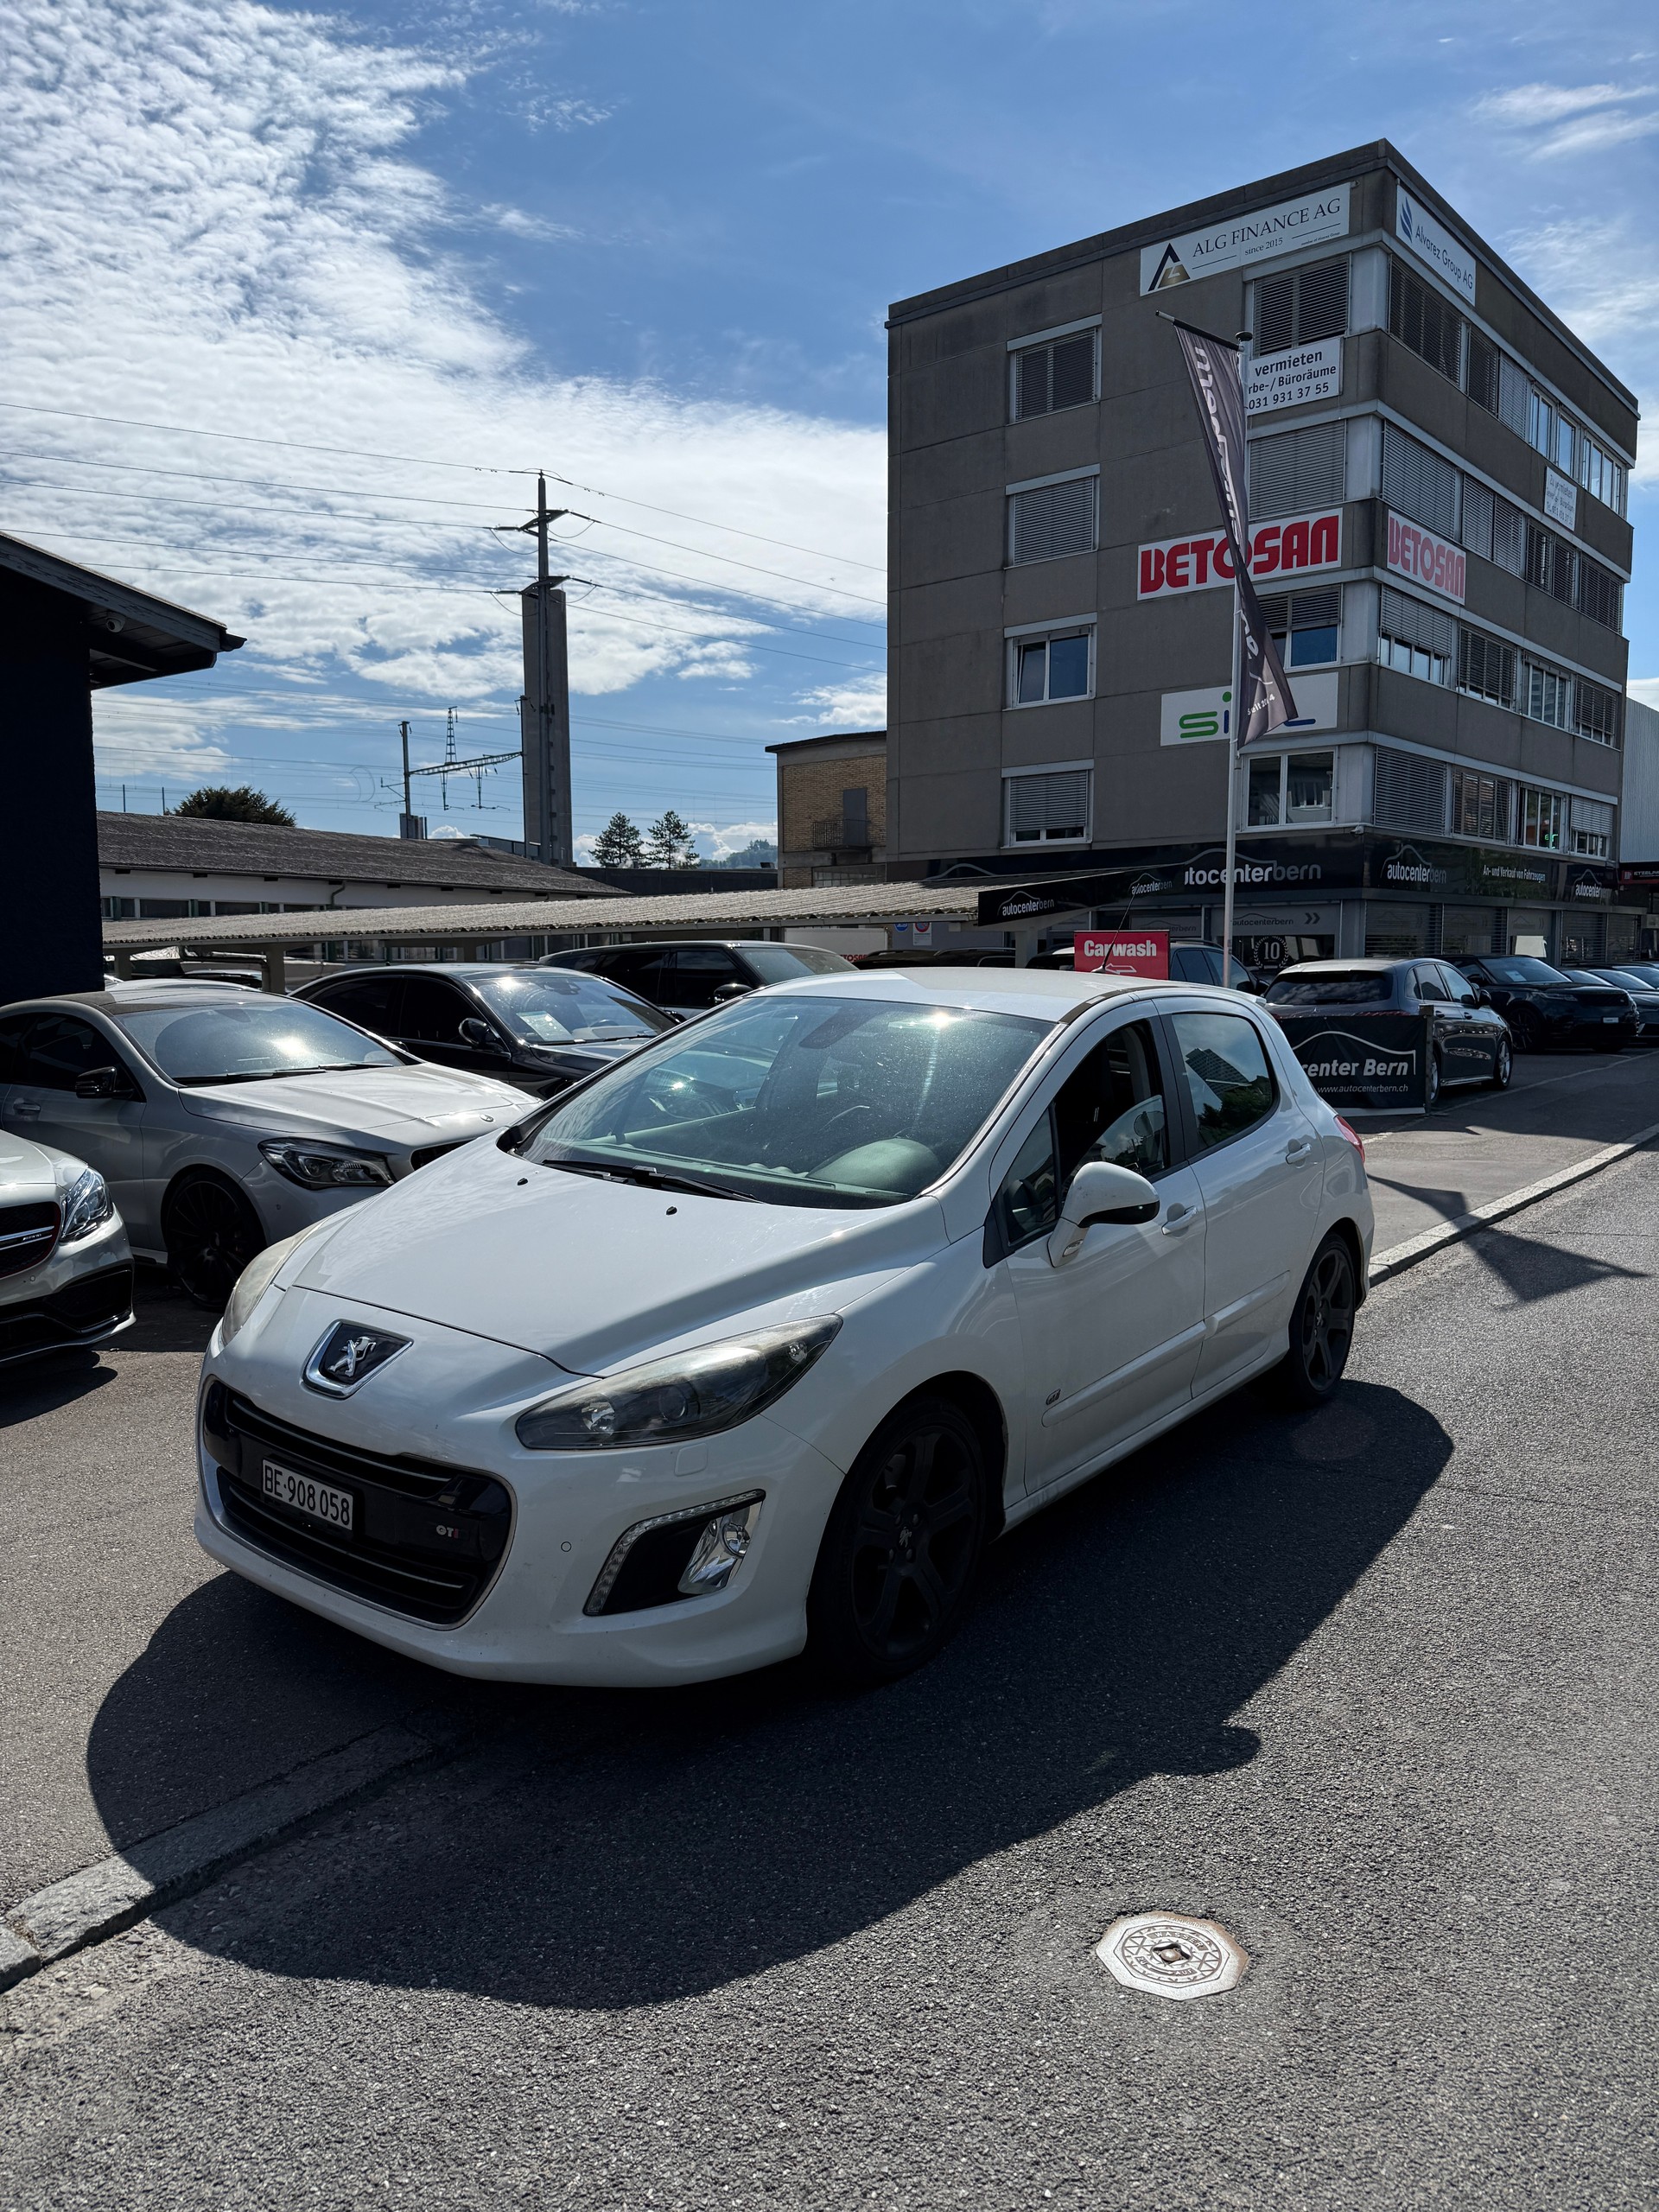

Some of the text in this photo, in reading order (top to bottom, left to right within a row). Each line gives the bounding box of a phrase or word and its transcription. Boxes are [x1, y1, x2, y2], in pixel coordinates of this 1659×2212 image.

[1192, 198, 1341, 257] ALG FINANCE AG
[1244, 238, 1283, 256] since 2015
[1415, 225, 1473, 289] Alvarez Group AG
[1255, 351, 1322, 377] vermieten
[1279, 365, 1336, 387] Büroräume
[1249, 382, 1329, 410] 031 931 37 55
[1141, 515, 1338, 594] BETOSAN
[1389, 516, 1465, 599] BETOSAN
[1084, 939, 1157, 957] Carwash
[1263, 942, 1281, 960] 10
[1363, 1058, 1408, 1077] Bern
[1155, 1931, 1204, 1948] WASSER
